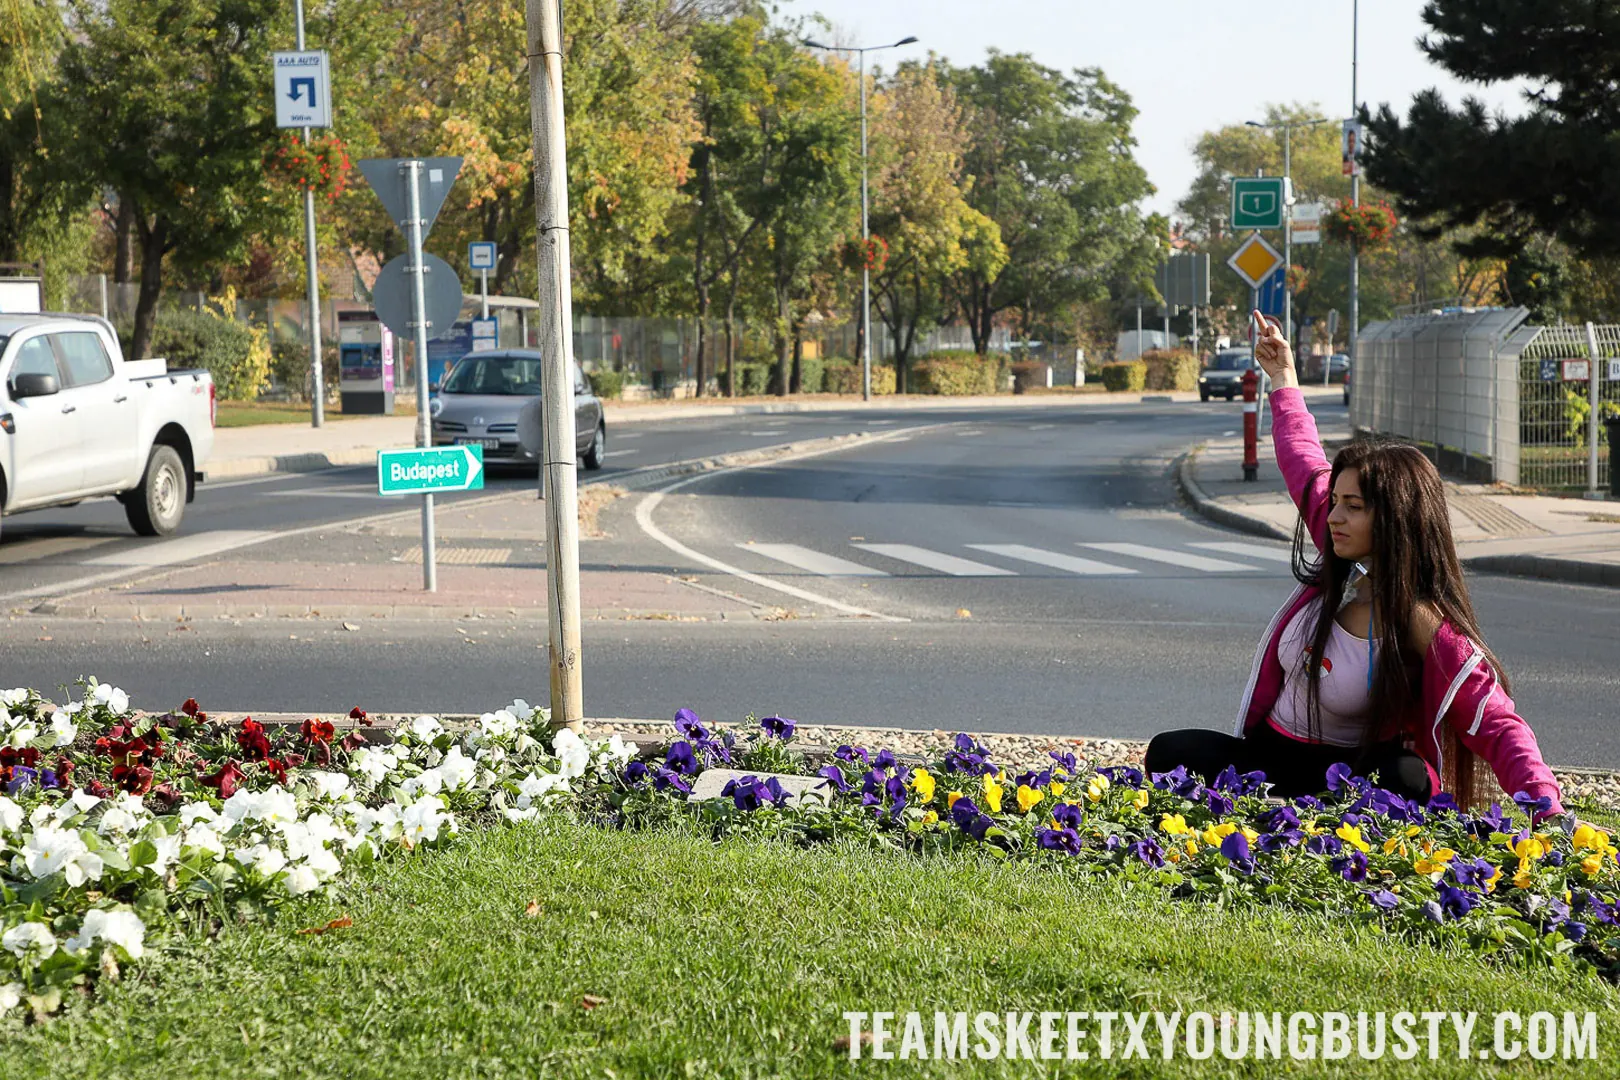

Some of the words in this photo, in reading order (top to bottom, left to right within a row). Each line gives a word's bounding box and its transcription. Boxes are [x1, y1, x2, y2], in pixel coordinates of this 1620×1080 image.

[277, 57, 295, 65] AAA
[298, 56, 319, 65] AUTO
[1253, 196, 1260, 211] 1
[390, 459, 459, 483] Budapest
